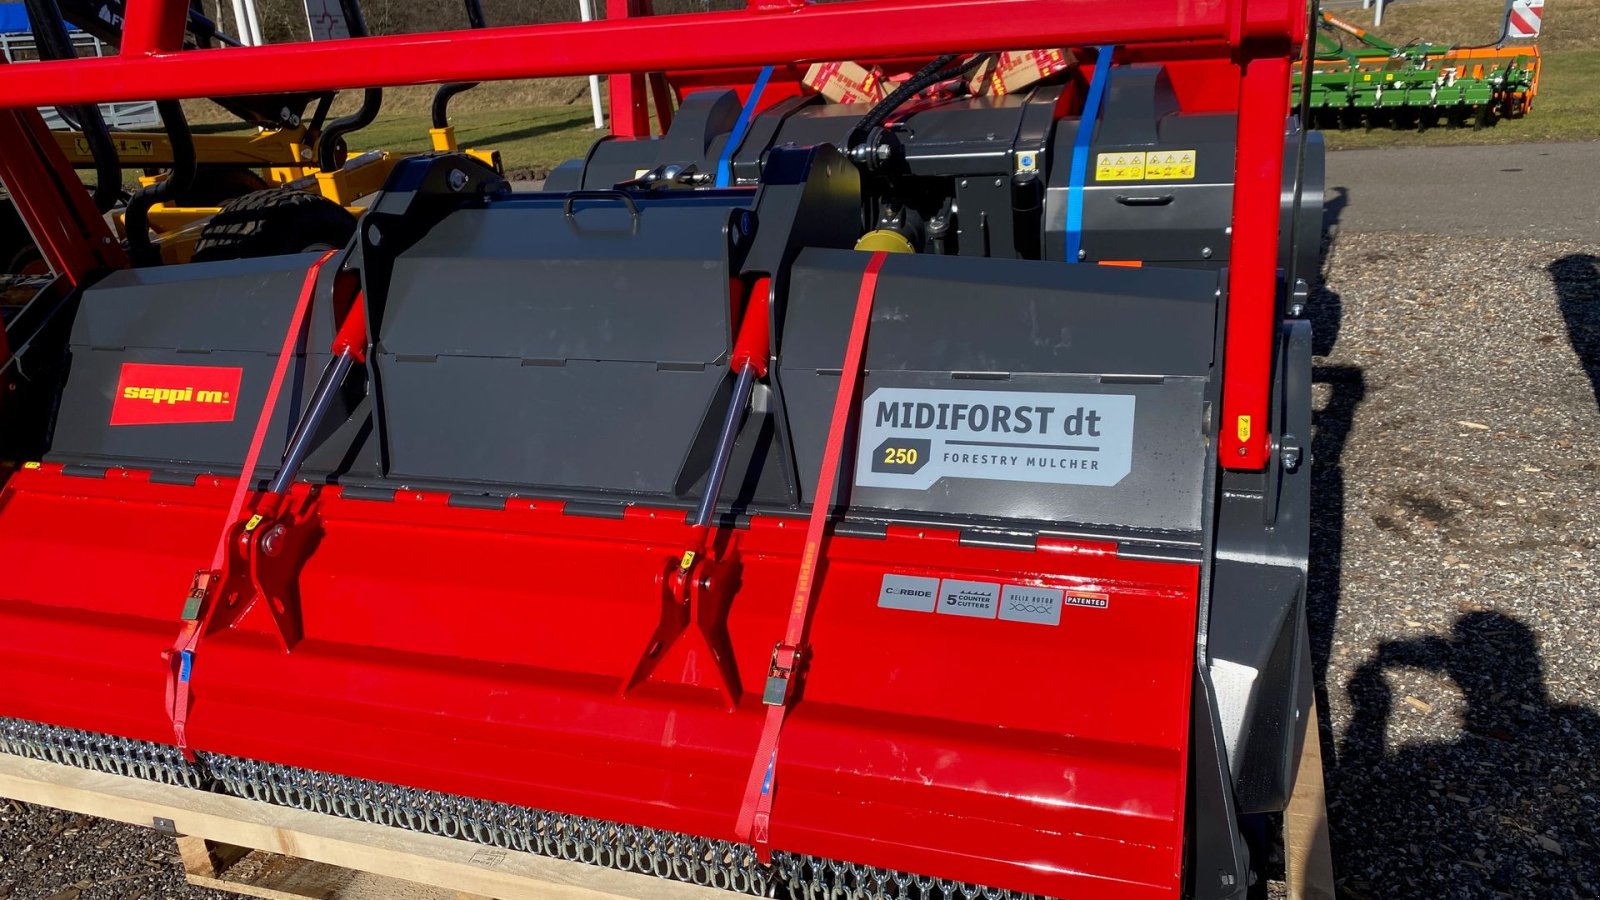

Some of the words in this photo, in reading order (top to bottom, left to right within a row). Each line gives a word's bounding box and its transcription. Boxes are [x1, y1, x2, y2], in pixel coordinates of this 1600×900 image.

[123, 386, 194, 405] seppi
[875, 401, 1055, 434] MIDIFORST
[1063, 406, 1102, 437] dt
[883, 447, 918, 465] 250
[943, 452, 1018, 467] FORESTRY
[1026, 457, 1099, 471] MULCHER
[946, 594, 957, 605] 5
[958, 595, 990, 603] COUNTER
[957, 601, 990, 609] CUTTERS
[1067, 596, 1106, 606] PATENTED
